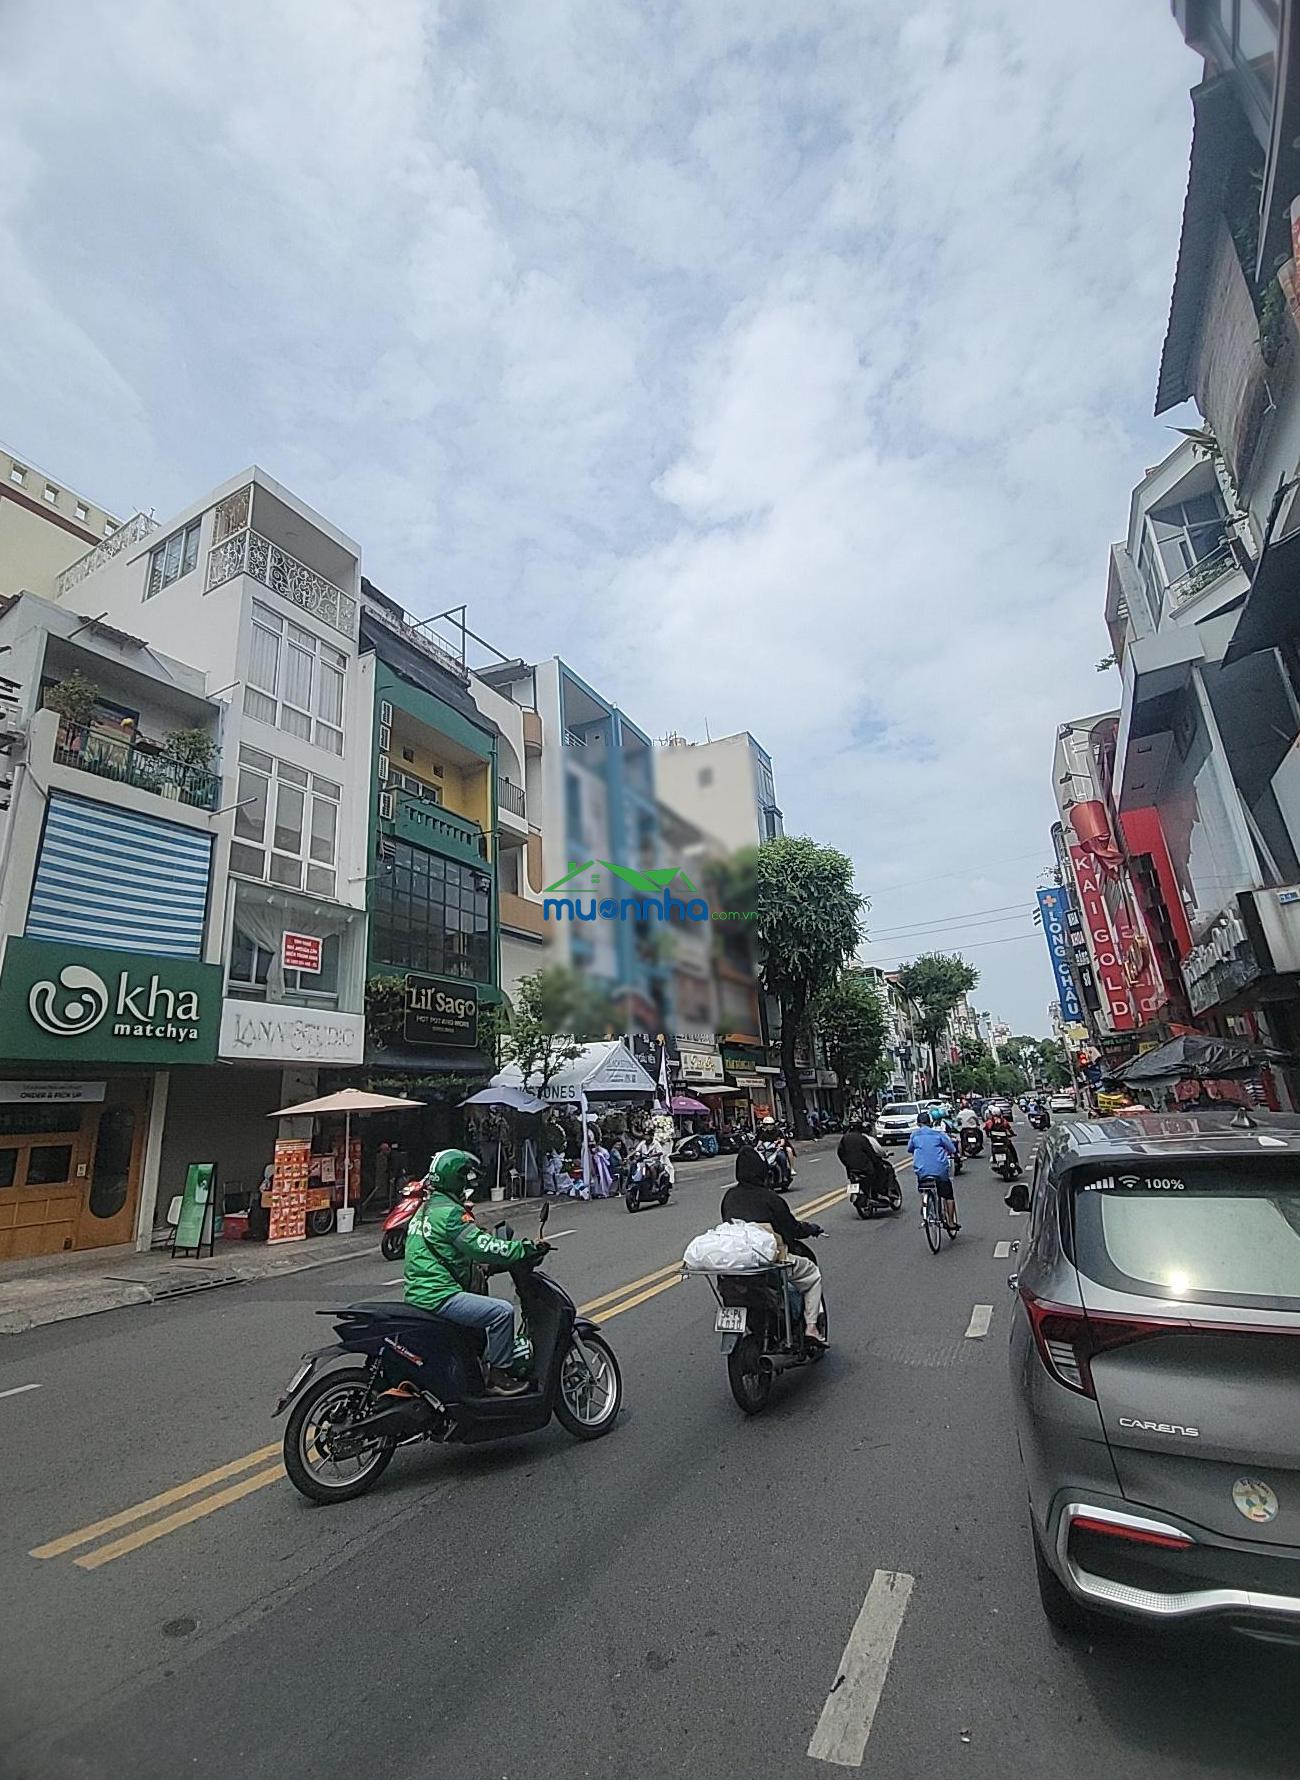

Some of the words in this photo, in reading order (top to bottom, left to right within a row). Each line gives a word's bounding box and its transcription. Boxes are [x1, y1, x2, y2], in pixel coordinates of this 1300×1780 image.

[1048, 911, 1067, 957] LONG
[1058, 963, 1080, 1015] CHÂU
[116, 971, 200, 1022] kha
[113, 1022, 199, 1042] matchya
[1143, 1177, 1185, 1191] 100%
[1119, 1416, 1199, 1438] CARENS
